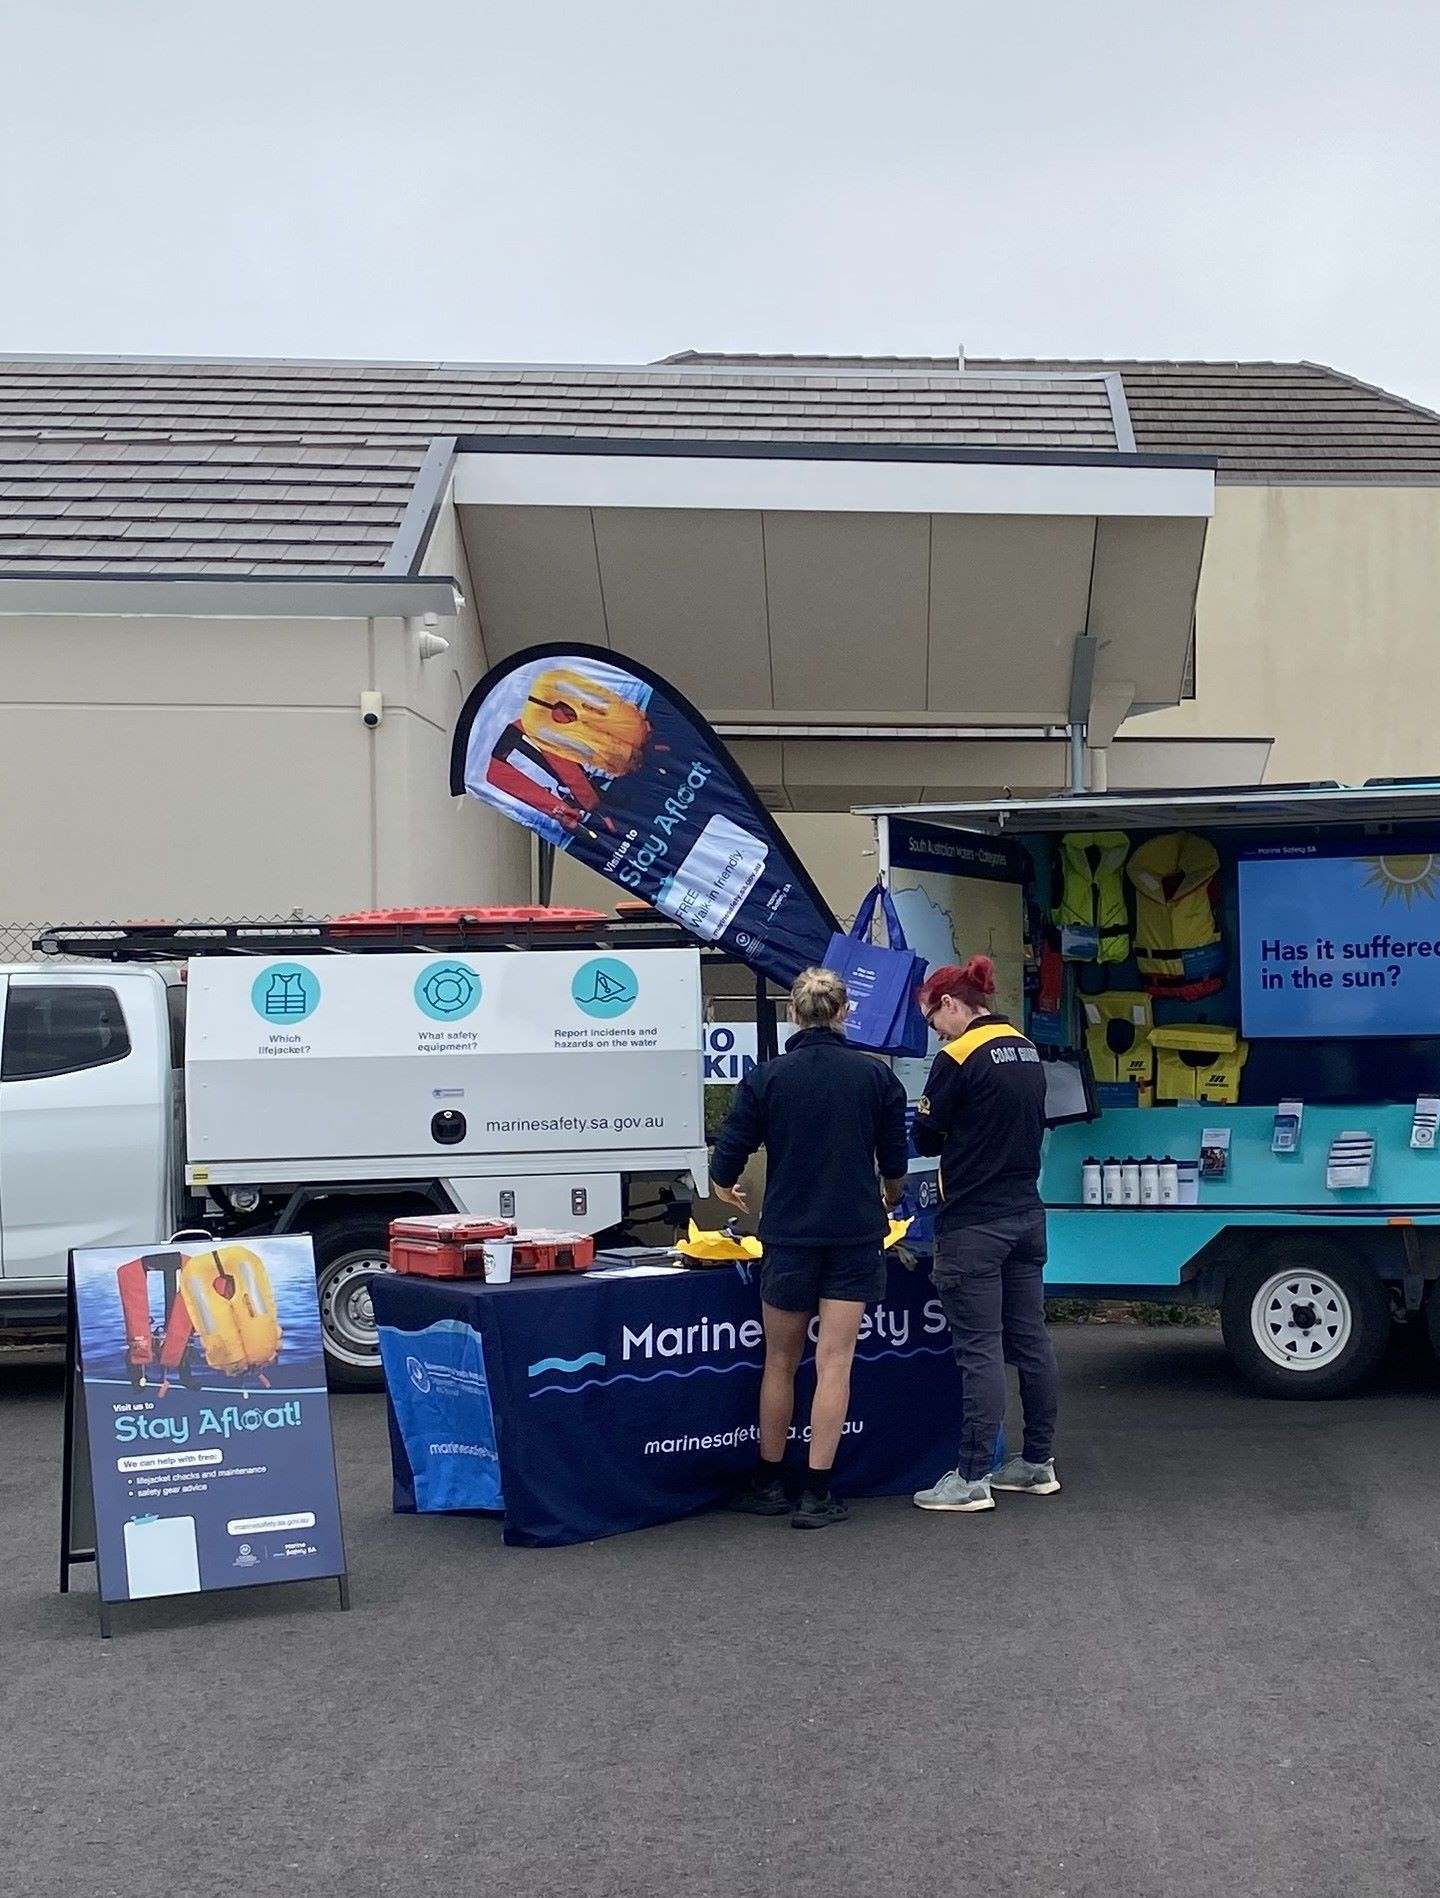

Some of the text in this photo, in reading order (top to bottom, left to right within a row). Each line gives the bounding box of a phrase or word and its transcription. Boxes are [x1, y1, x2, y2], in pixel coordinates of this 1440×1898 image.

[619, 761, 711, 887] Stay Afloat
[626, 829, 638, 841] to
[674, 887, 700, 920] FREE
[689, 889, 720, 930] Walk-in
[1261, 939, 1309, 962] Has
[1316, 938, 1334, 960] it
[1261, 965, 1402, 990] in the sun?
[269, 1034, 301, 1043] Which
[418, 1031, 479, 1042] What safety
[554, 1027, 658, 1039] Report incidents and
[418, 1042, 478, 1053] equipment?
[554, 1038, 658, 1048] hazards on the water
[258, 1044, 311, 1056] lifejacket?
[622, 1317, 763, 1360] Marine
[923, 1300, 952, 1333] S
[113, 1403, 131, 1412] Visit
[144, 1402, 154, 1410] to
[115, 1401, 301, 1444] Stay Afloat!
[124, 1453, 218, 1468] We can help with free:
[202, 1470, 217, 1478] and
